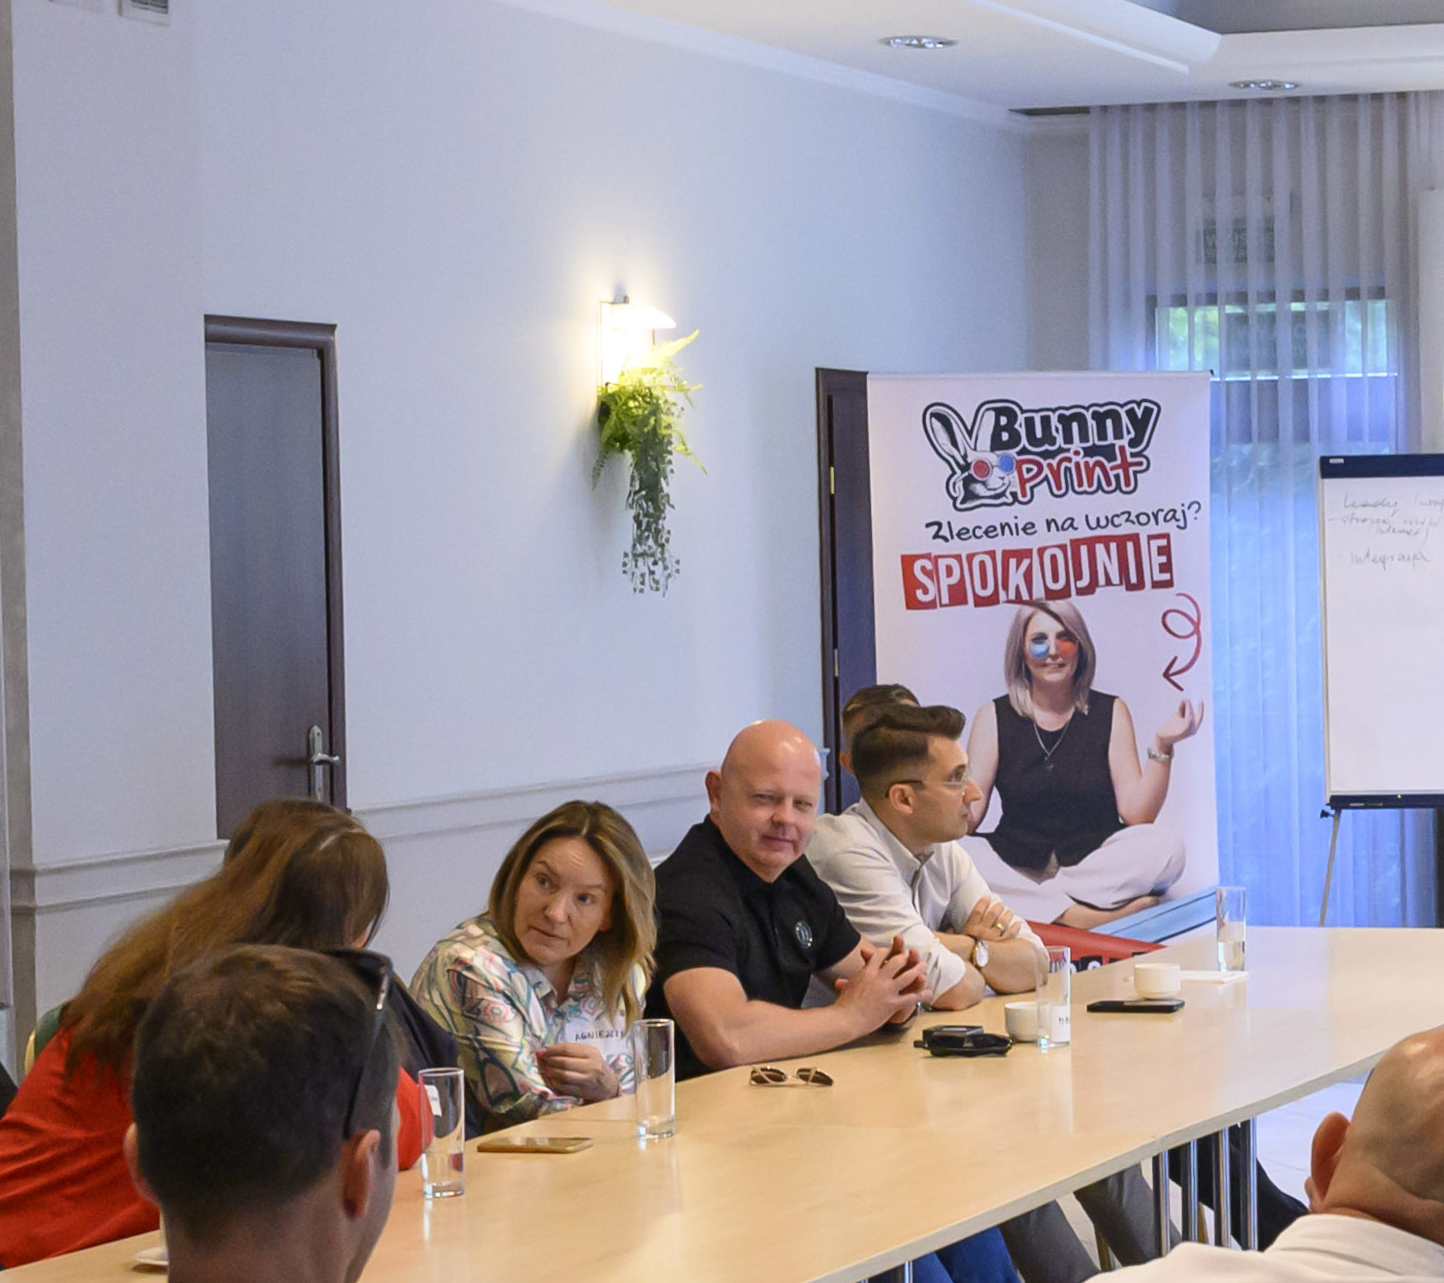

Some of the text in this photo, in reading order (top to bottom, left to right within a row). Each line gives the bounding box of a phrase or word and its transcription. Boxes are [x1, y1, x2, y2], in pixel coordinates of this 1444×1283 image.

[989, 403, 1157, 450] Bunny
[924, 500, 1202, 543] Zlecenie na wczoraj?
[910, 537, 1173, 606] SPOKOJNIE
